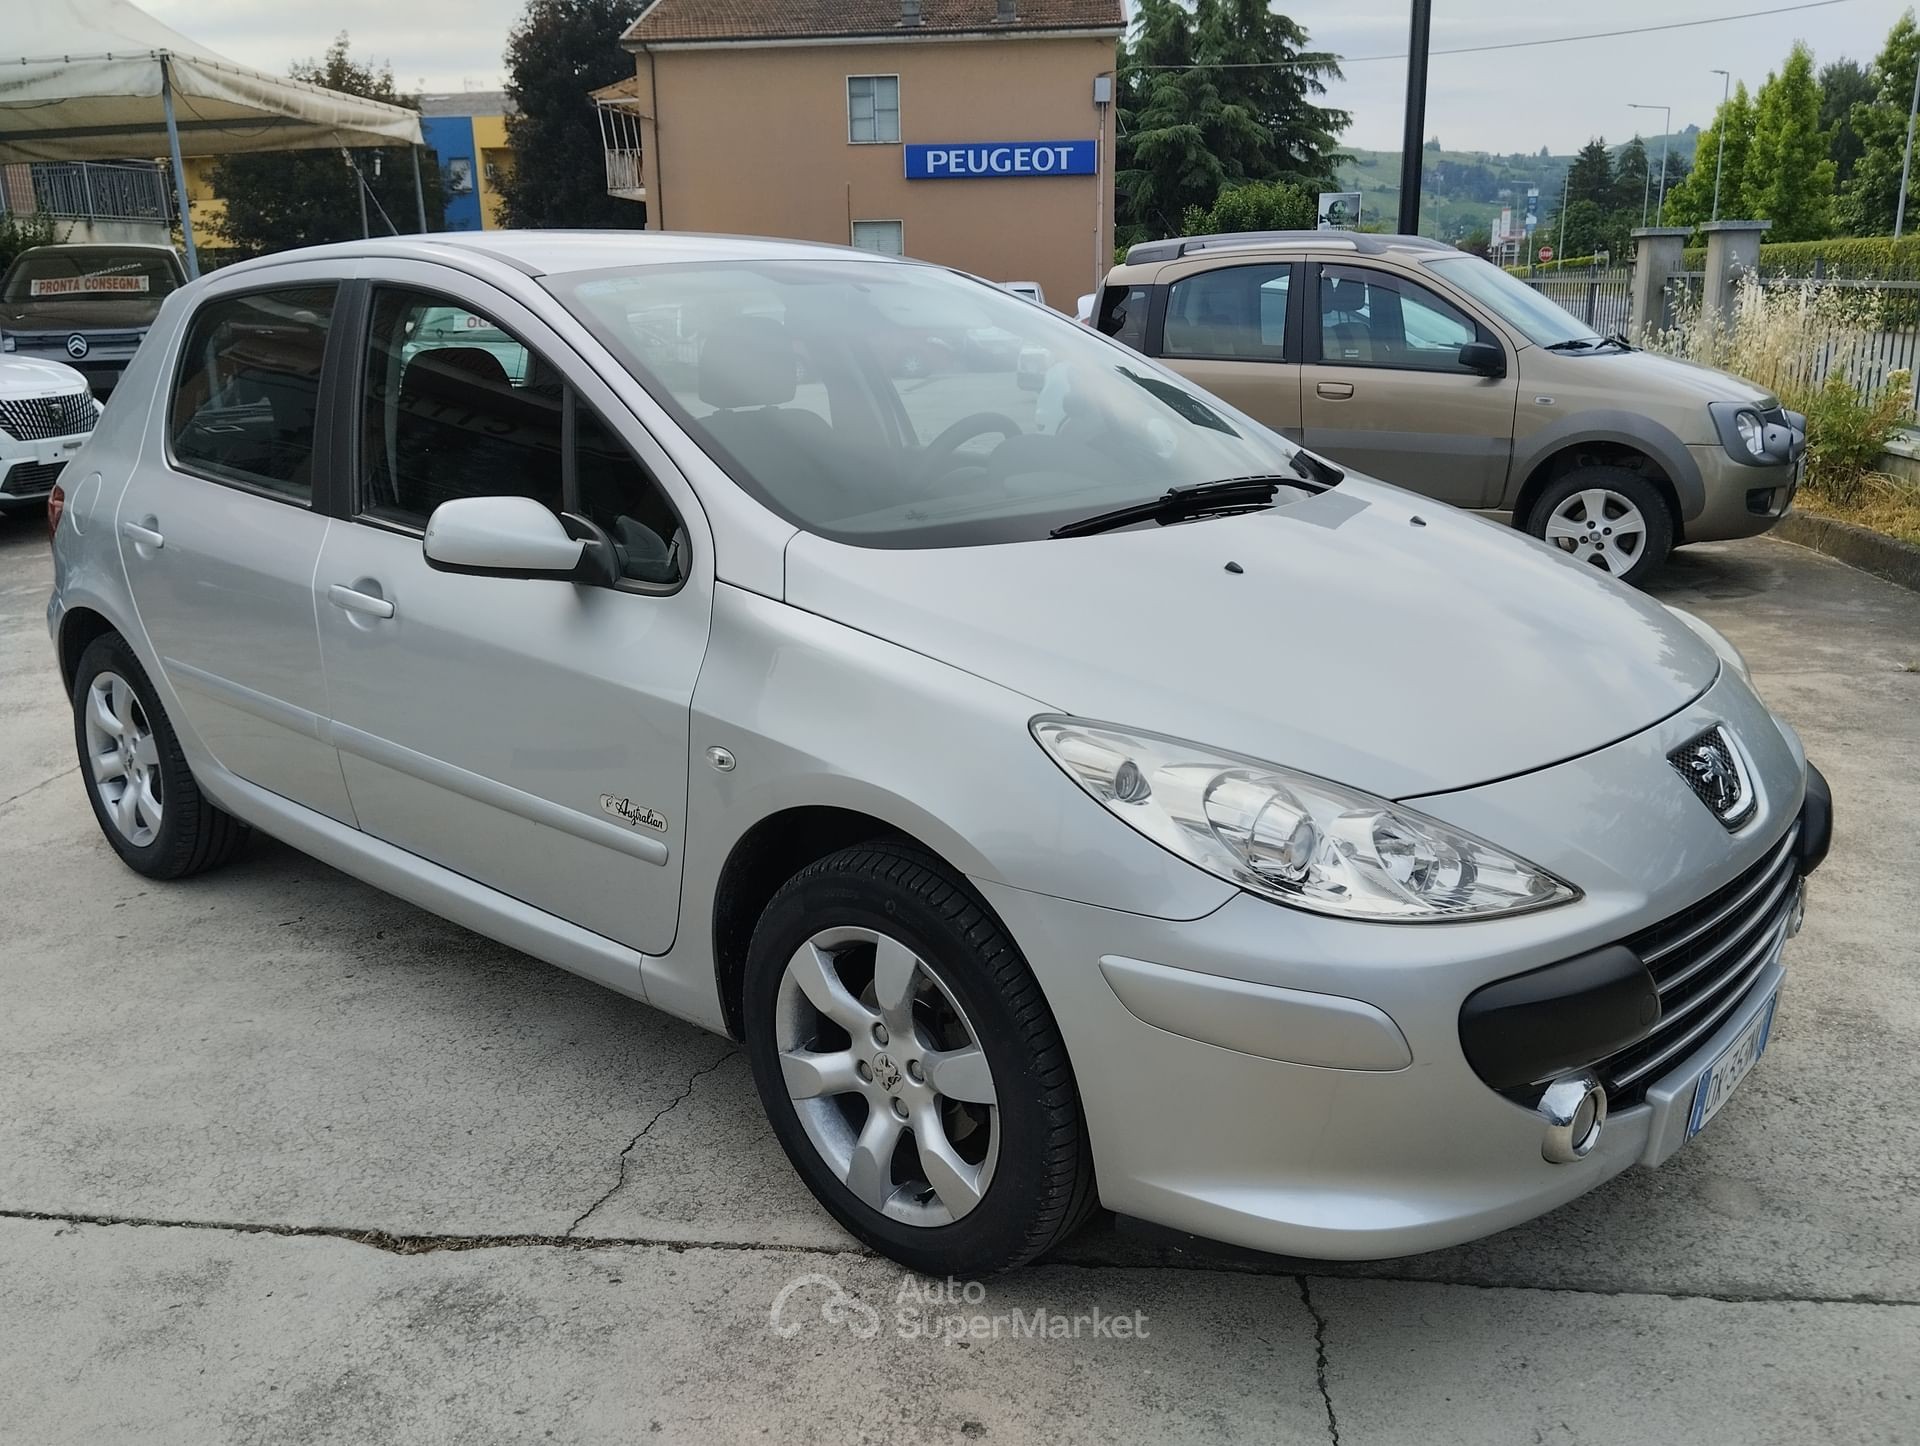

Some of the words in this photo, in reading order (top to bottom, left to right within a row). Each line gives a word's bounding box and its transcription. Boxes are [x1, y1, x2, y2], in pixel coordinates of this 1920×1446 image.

[926, 147, 1074, 174] PEUGEOT
[39, 280, 80, 293] PRONTA
[84, 278, 140, 290] CONSEGNA
[615, 798, 663, 829] Australian
